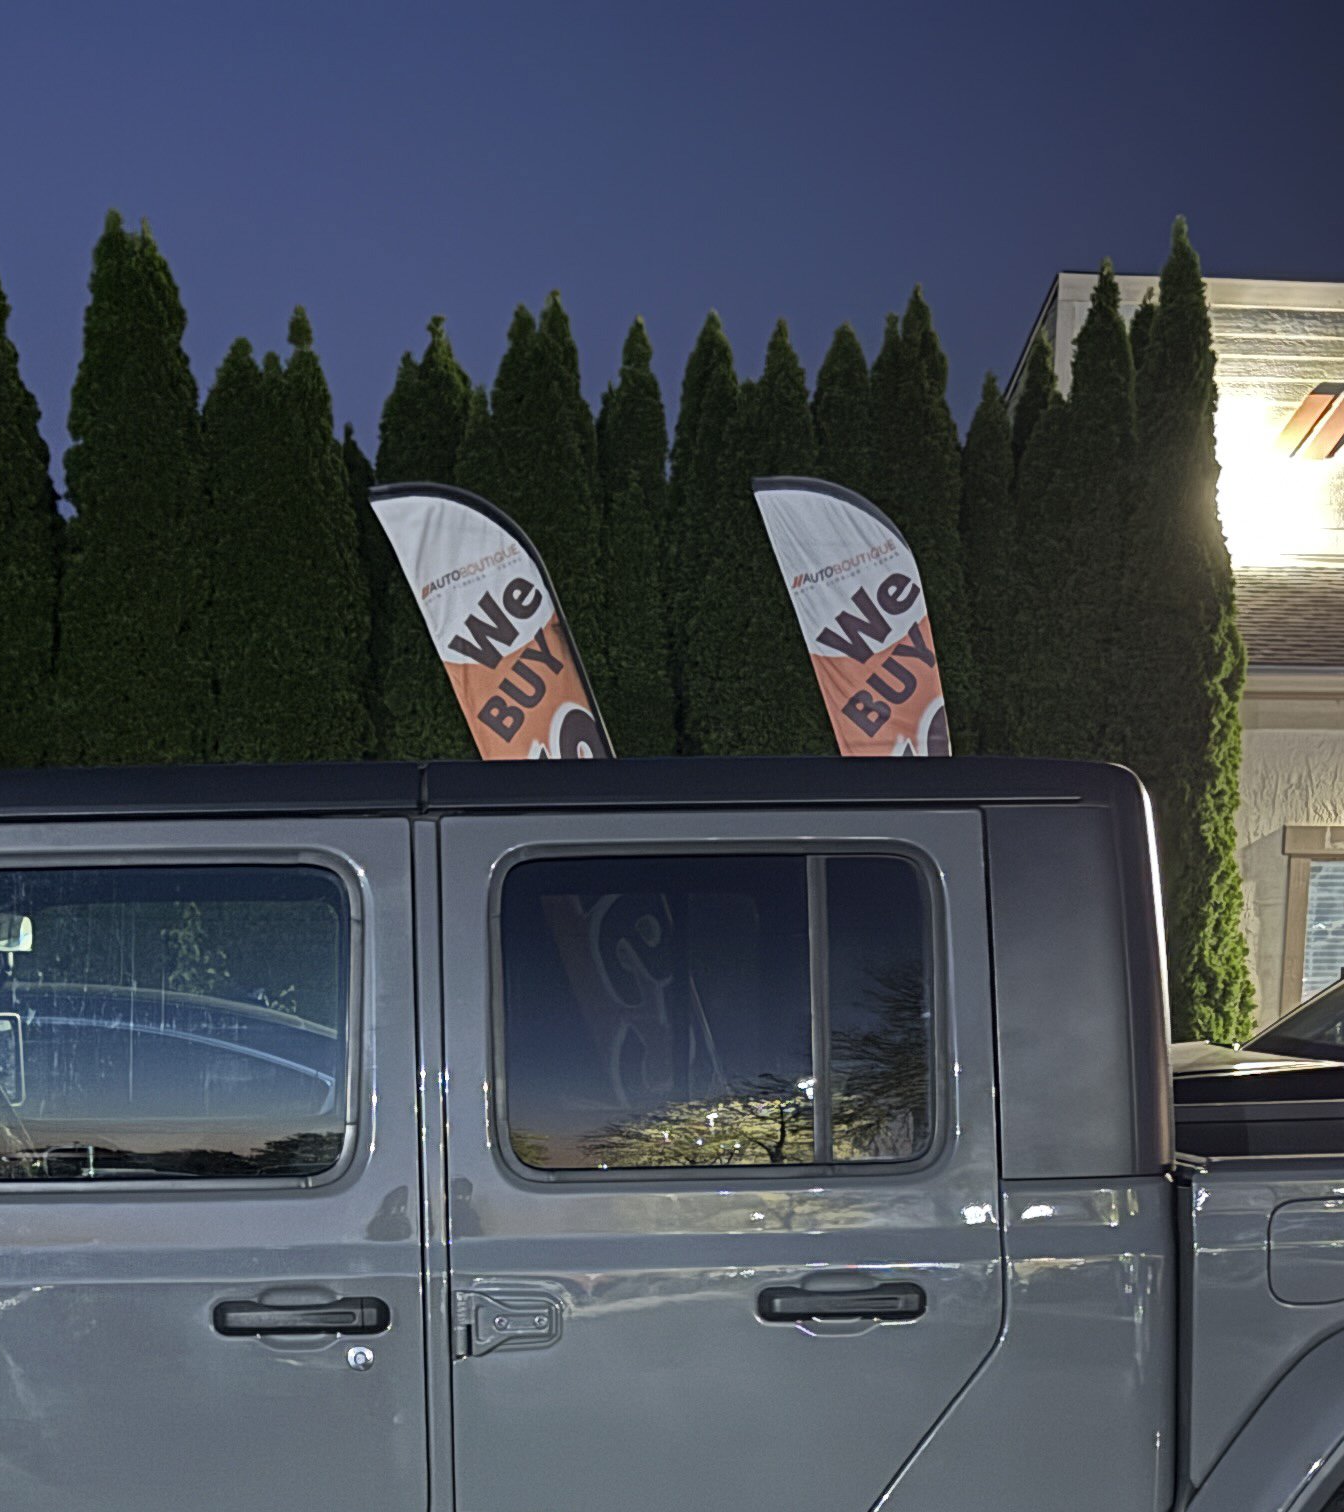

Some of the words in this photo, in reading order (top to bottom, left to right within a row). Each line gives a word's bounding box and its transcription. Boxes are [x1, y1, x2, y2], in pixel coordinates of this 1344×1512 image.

[448, 577, 543, 670] We
[816, 573, 921, 664] We
[477, 627, 564, 744] BUY
[841, 621, 936, 738] BUY
